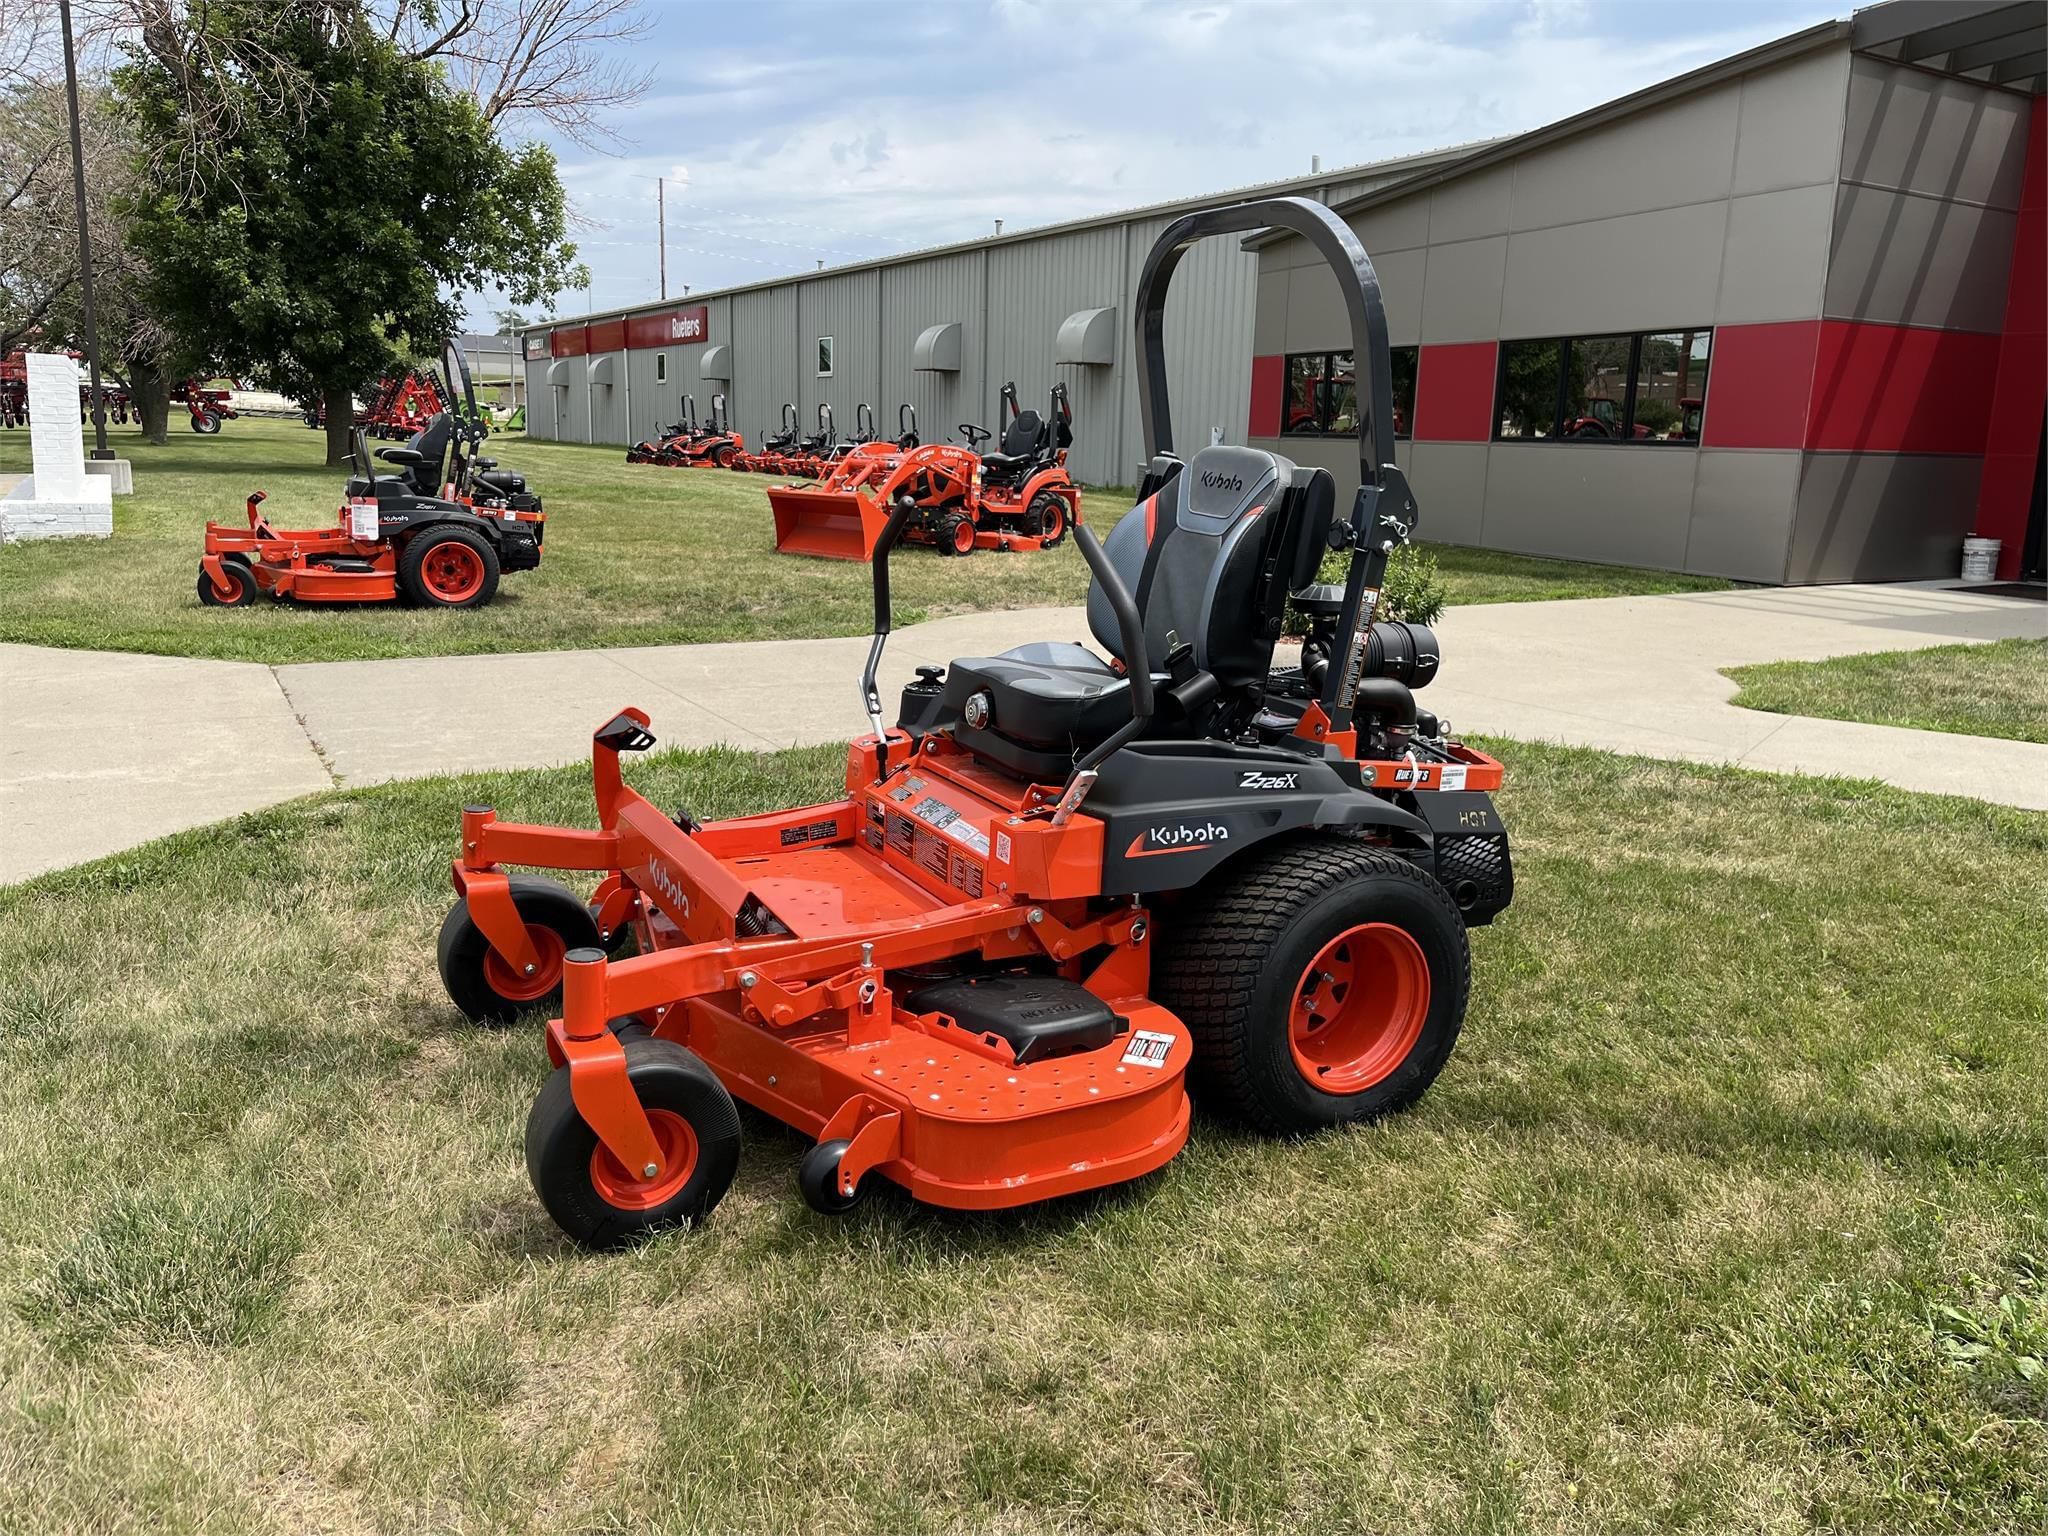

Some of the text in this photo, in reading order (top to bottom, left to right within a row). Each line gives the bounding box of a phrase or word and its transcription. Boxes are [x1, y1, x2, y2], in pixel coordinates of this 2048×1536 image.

[1200, 470, 1243, 492] Kubota
[1239, 771, 1299, 789] Z726X
[1459, 810, 1488, 827] HOT
[1151, 822, 1229, 845] Kubota
[650, 853, 689, 919] Kubota
